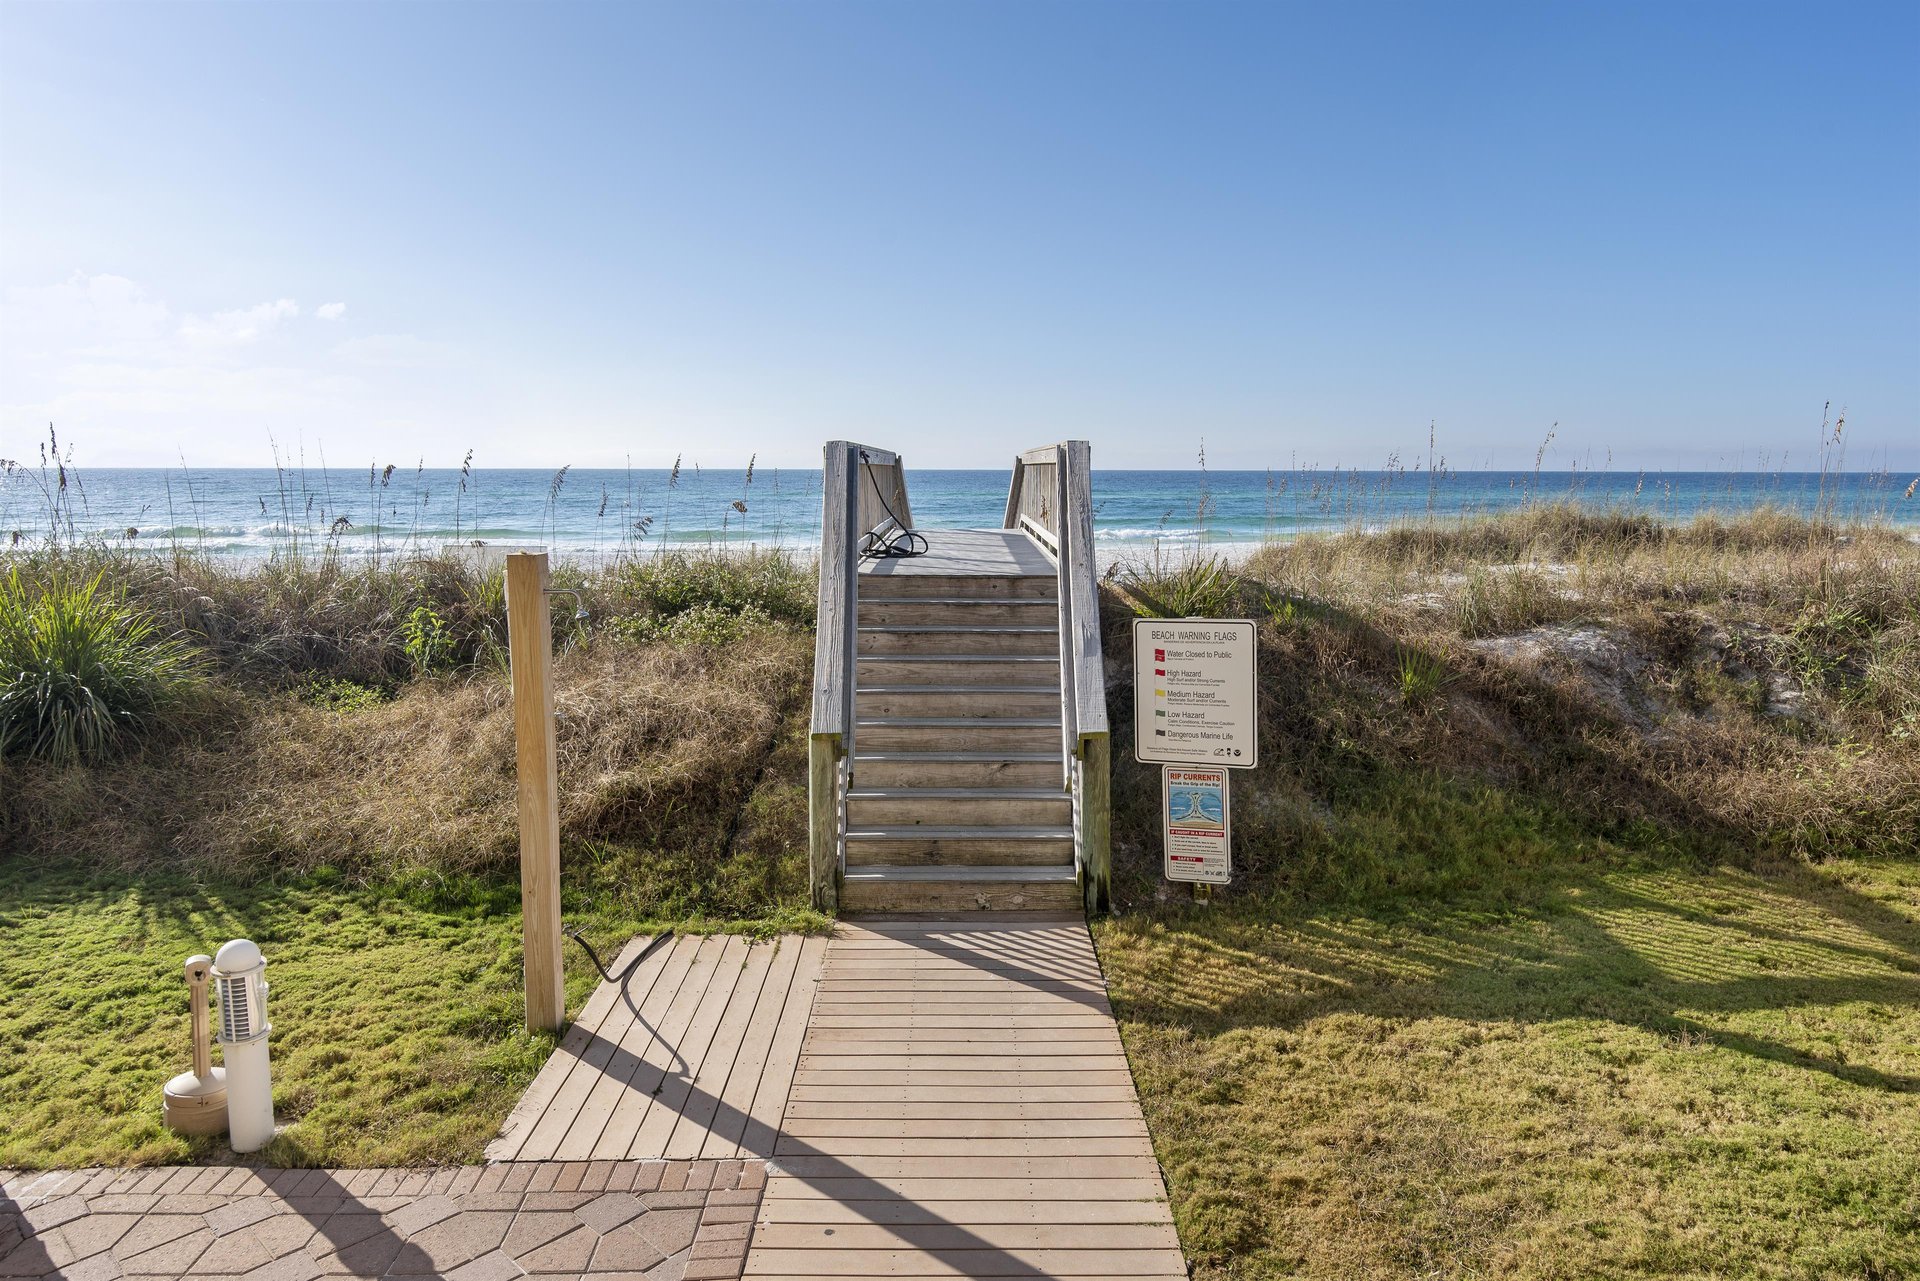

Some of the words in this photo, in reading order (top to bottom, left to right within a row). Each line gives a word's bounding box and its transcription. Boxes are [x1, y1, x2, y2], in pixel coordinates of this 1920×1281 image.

[1152, 631, 1175, 640] BEACH
[1178, 631, 1210, 640] WARNING
[1214, 632, 1237, 641] FLAGS
[1185, 650, 1205, 658] Closed
[1167, 670, 1180, 678] High
[1168, 730, 1199, 739] Dangerous
[1184, 774, 1220, 782] CURRENTS
